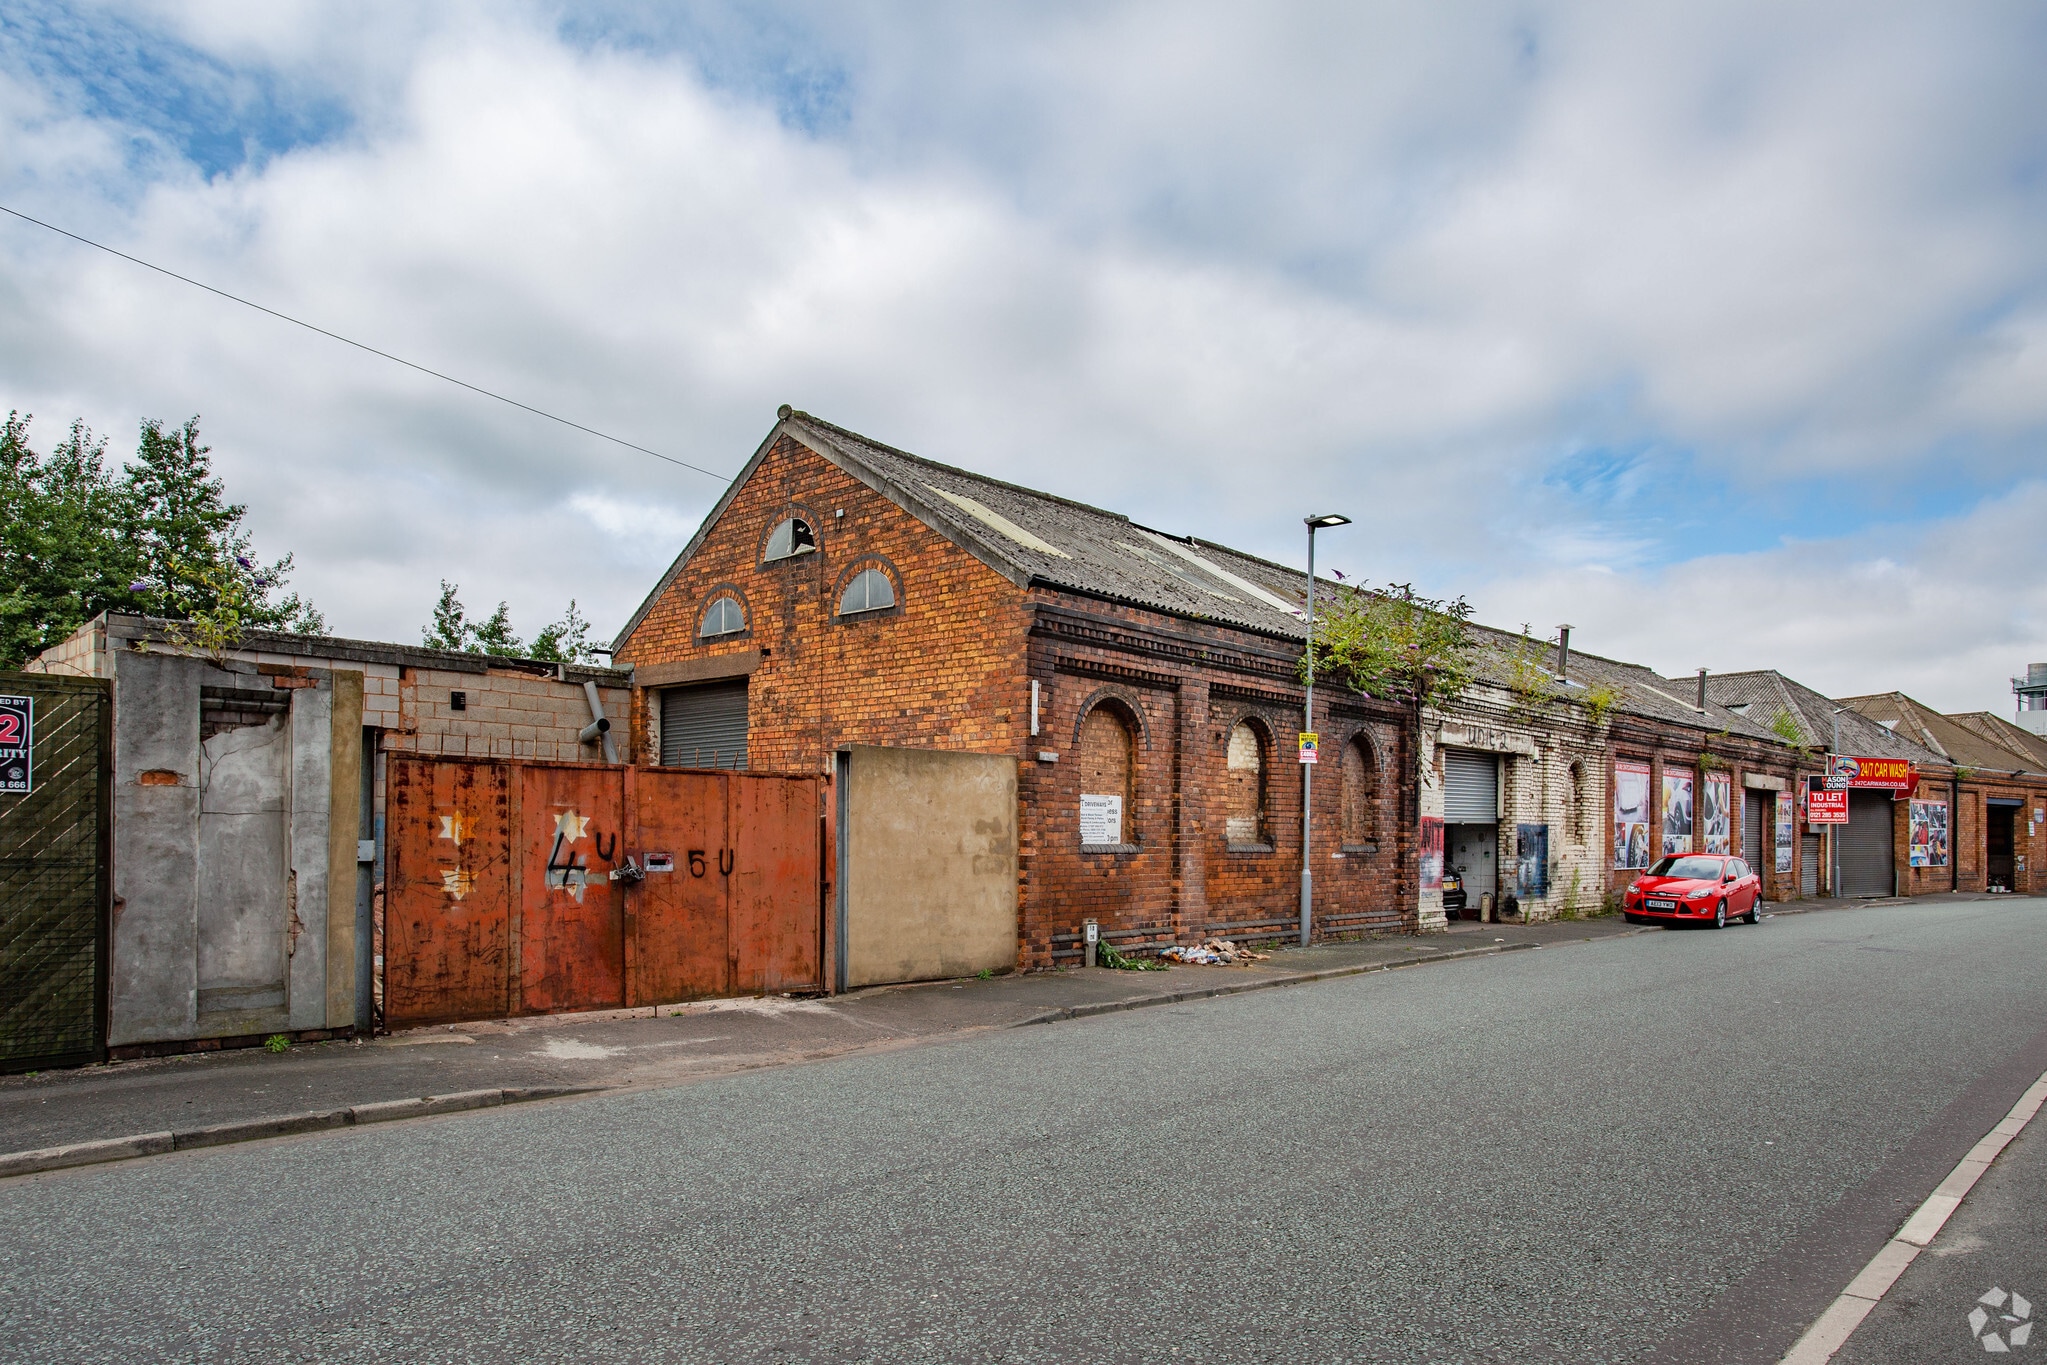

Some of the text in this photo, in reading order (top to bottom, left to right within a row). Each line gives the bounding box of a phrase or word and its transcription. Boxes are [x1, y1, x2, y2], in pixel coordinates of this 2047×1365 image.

[1499, 732, 1508, 750] 2
[1861, 762, 1907, 778] 24/7 CAR WASH
[8, 781, 26, 789] 666
[1854, 780, 1906, 788] 247CARWASH.CO.UK
[1811, 793, 1844, 802] TO LET
